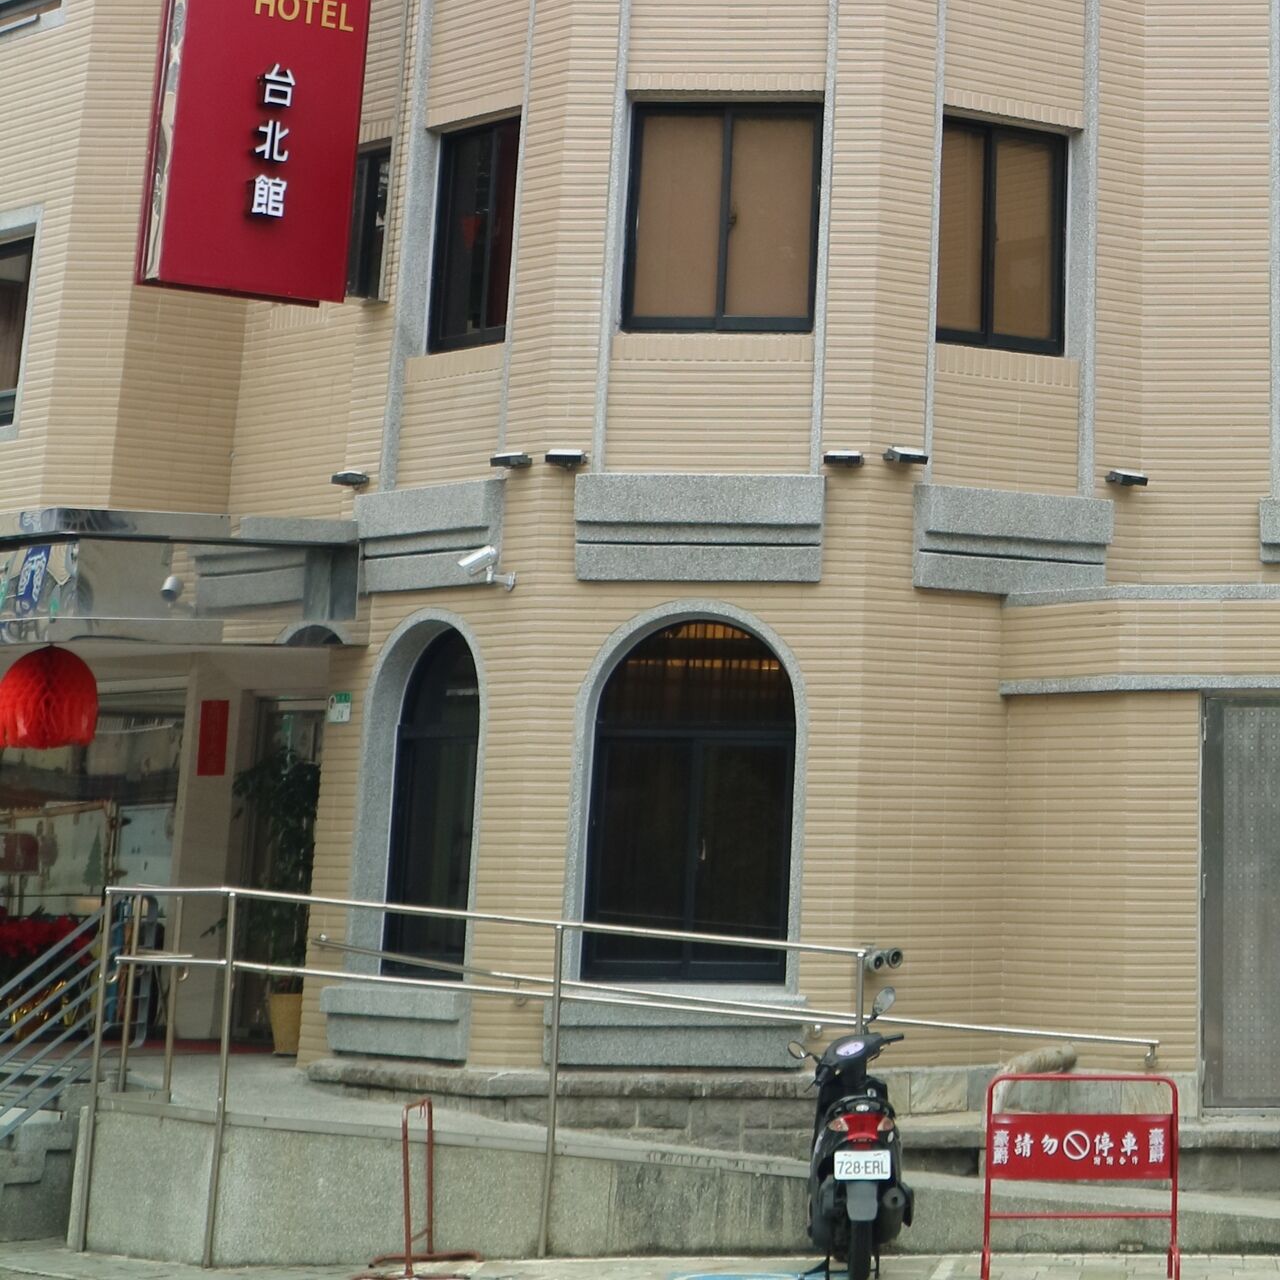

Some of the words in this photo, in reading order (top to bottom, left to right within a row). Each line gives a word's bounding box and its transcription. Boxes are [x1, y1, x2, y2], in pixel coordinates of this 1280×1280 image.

[251, 62, 296, 218] 台北館
[1014, 1132, 1059, 1158] 請勿
[1093, 1131, 1139, 1157] 停車
